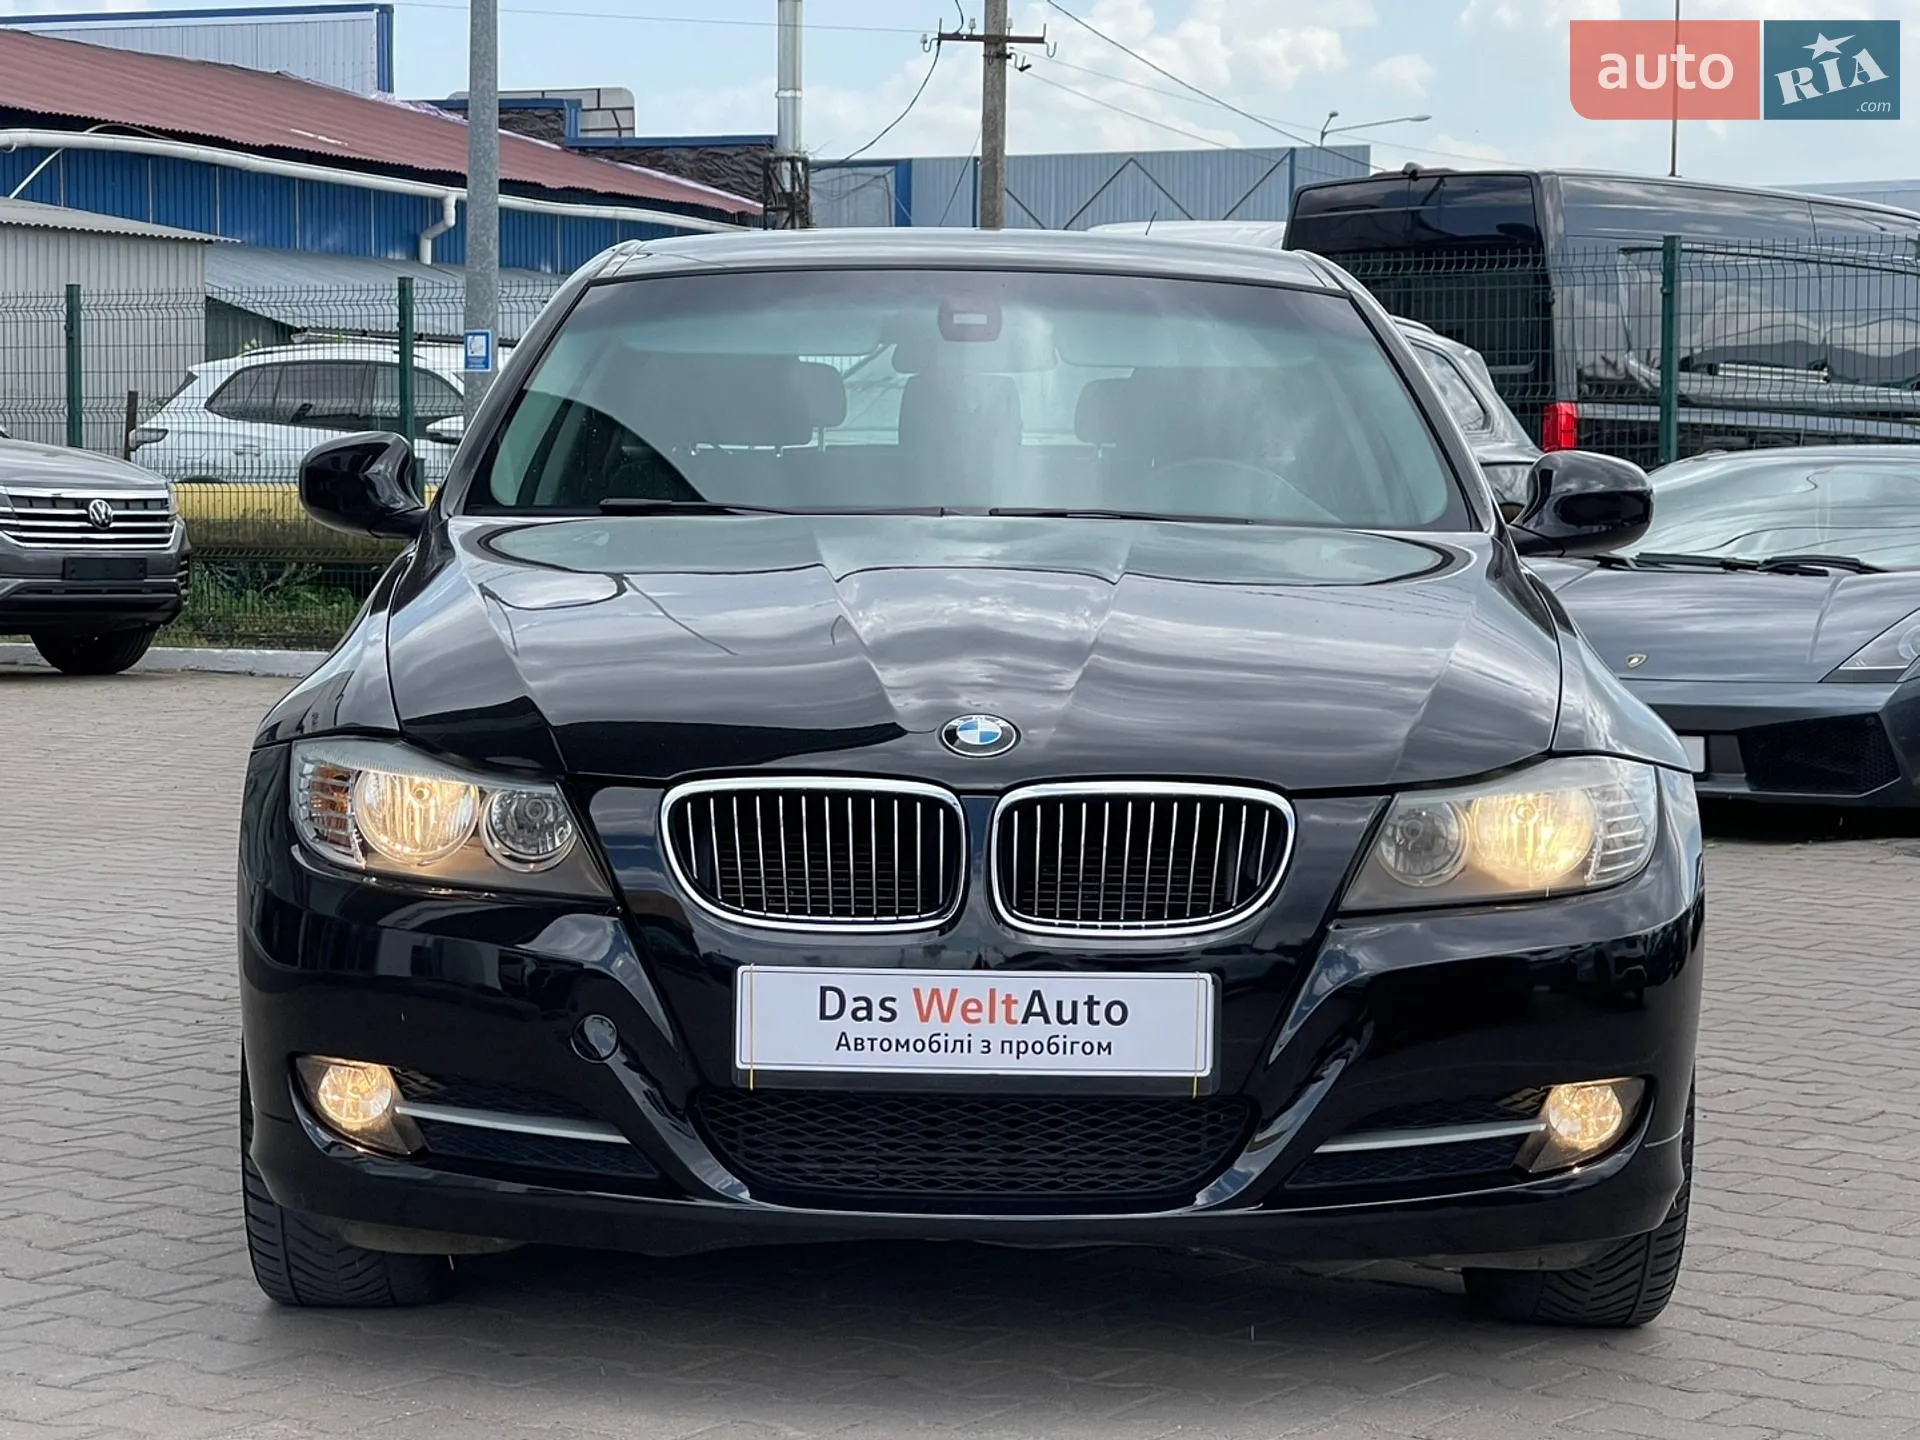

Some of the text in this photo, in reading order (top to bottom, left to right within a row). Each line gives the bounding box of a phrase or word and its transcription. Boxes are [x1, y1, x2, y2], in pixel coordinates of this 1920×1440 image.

[818, 985, 1129, 1026] Das WeltAuto
[835, 1031, 1113, 1059] Автомобілі з пробігом
